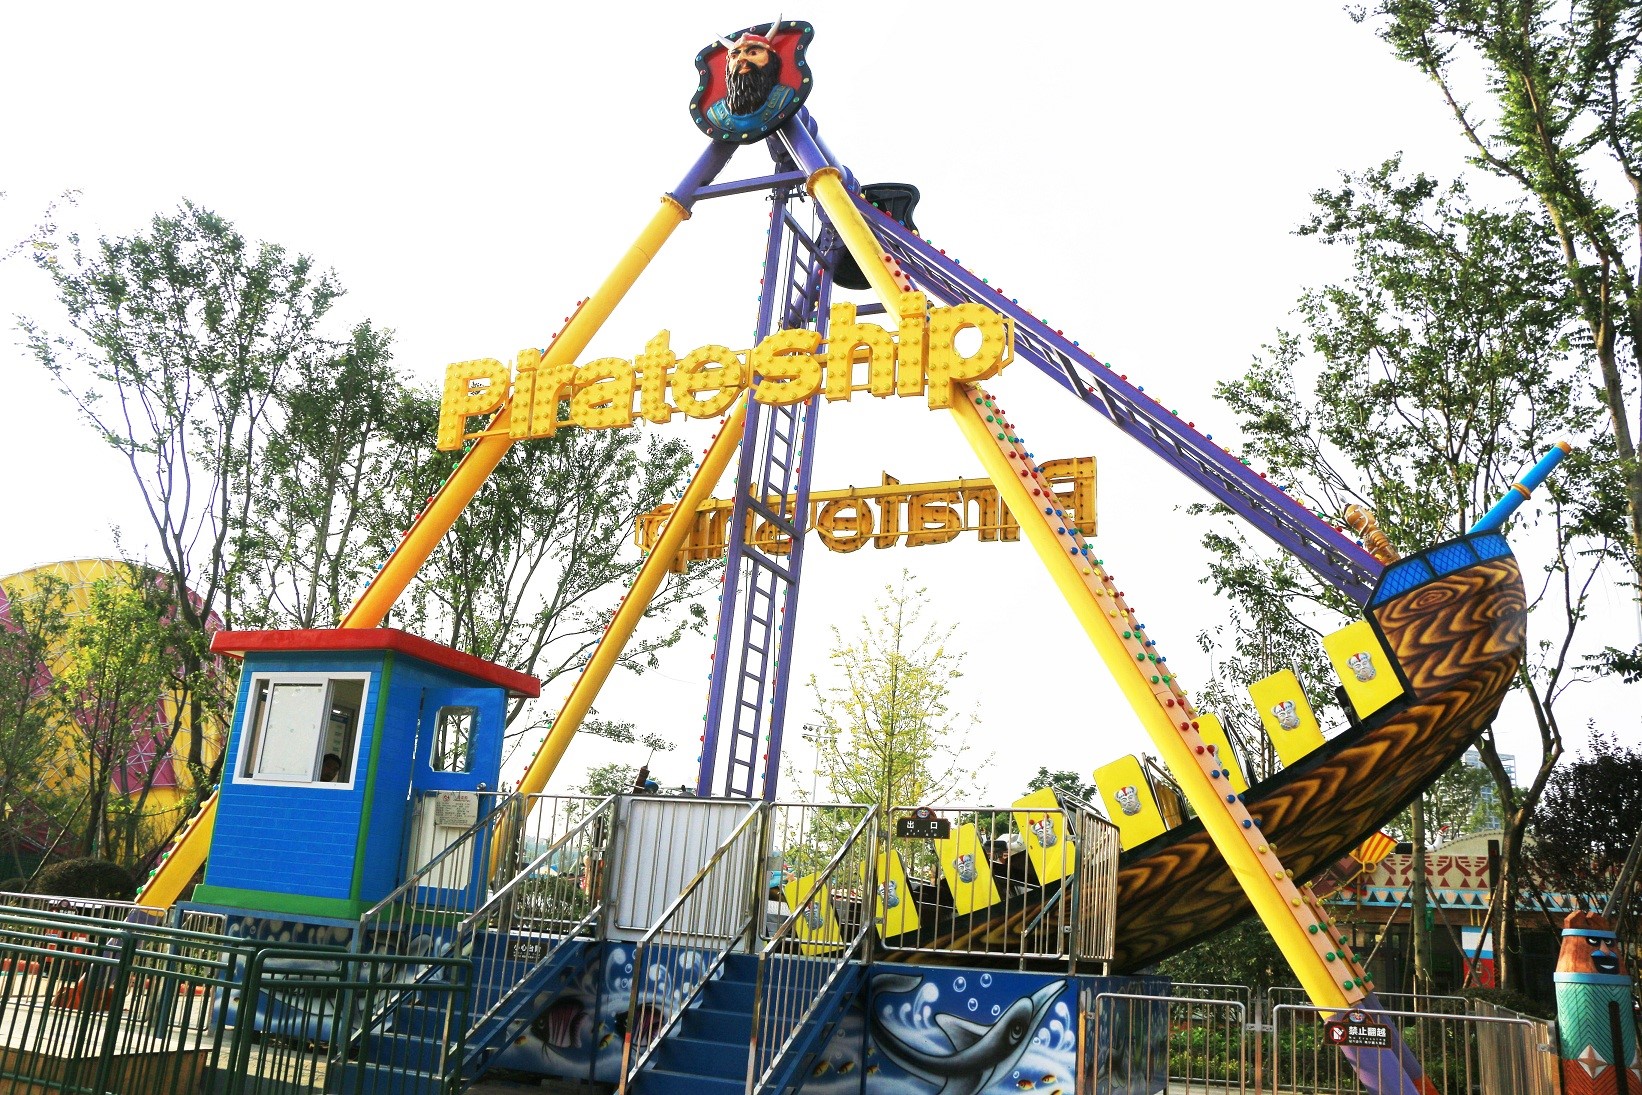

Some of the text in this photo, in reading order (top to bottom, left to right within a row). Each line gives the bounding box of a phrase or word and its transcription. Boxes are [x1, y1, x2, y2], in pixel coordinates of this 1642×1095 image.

[907, 820, 938, 829] 出口
[1348, 1026, 1387, 1037] 禁止翻越
